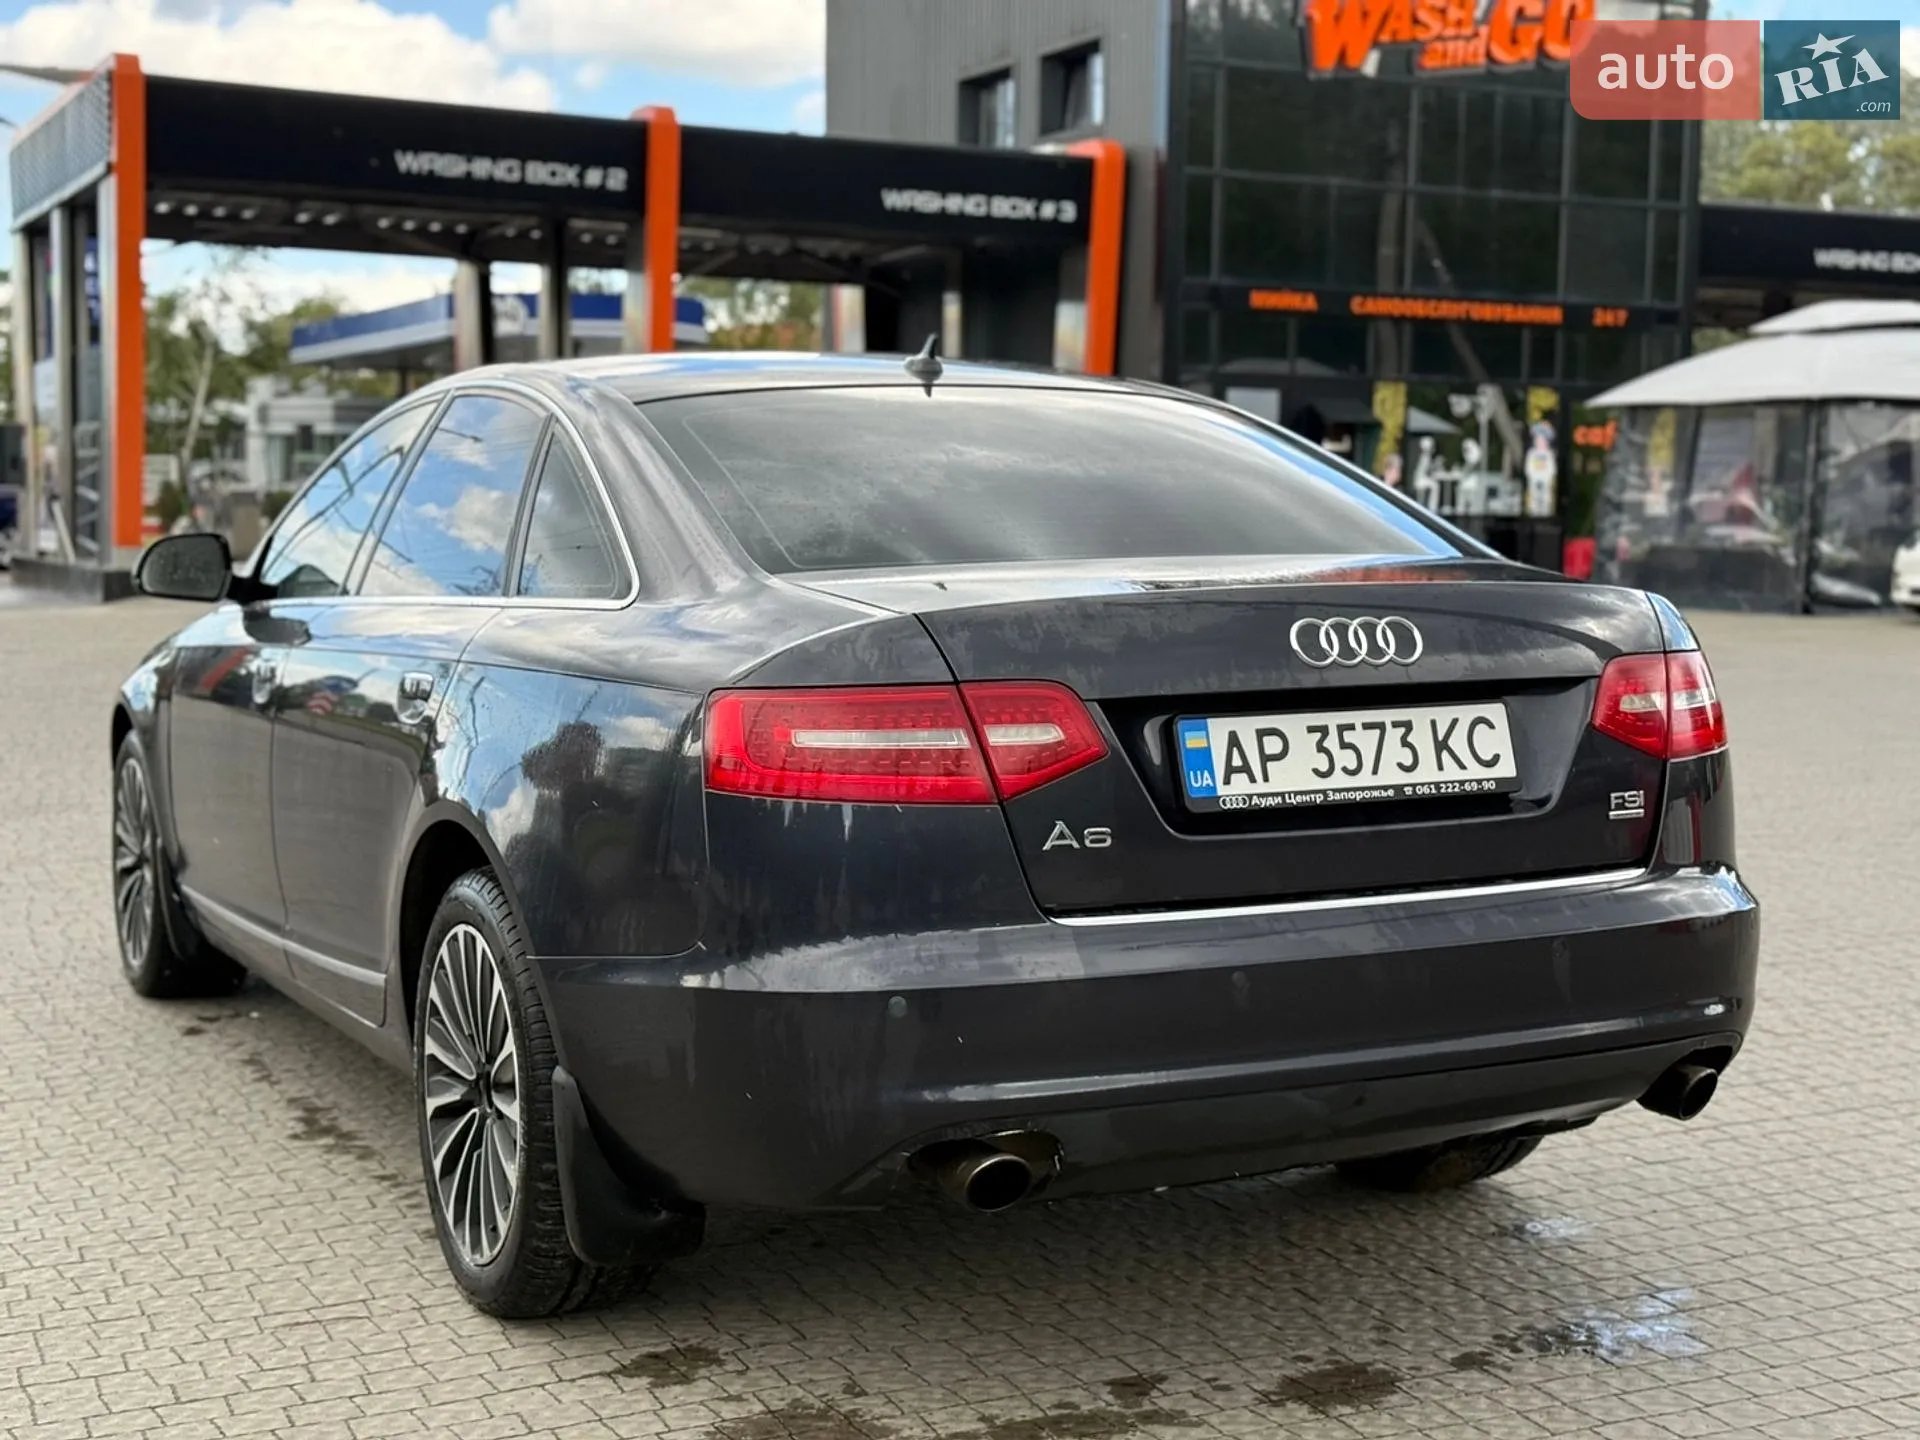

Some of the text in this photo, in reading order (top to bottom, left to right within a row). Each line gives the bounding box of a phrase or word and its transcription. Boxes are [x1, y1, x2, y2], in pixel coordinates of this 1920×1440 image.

[394, 150, 522, 183] WASHING
[524, 160, 581, 188] BOX
[605, 167, 628, 192] 2
[880, 187, 989, 217] WASHING
[989, 194, 1037, 220] BOX
[1057, 200, 1077, 223] 3
[1222, 716, 1501, 786] AP 3573 KC
[1189, 769, 1214, 788] UA
[1251, 779, 1497, 808] Ауди Центр Запорожье 061 222-69-90
[1609, 789, 1645, 810] FSI
[1042, 820, 1112, 851] A6
